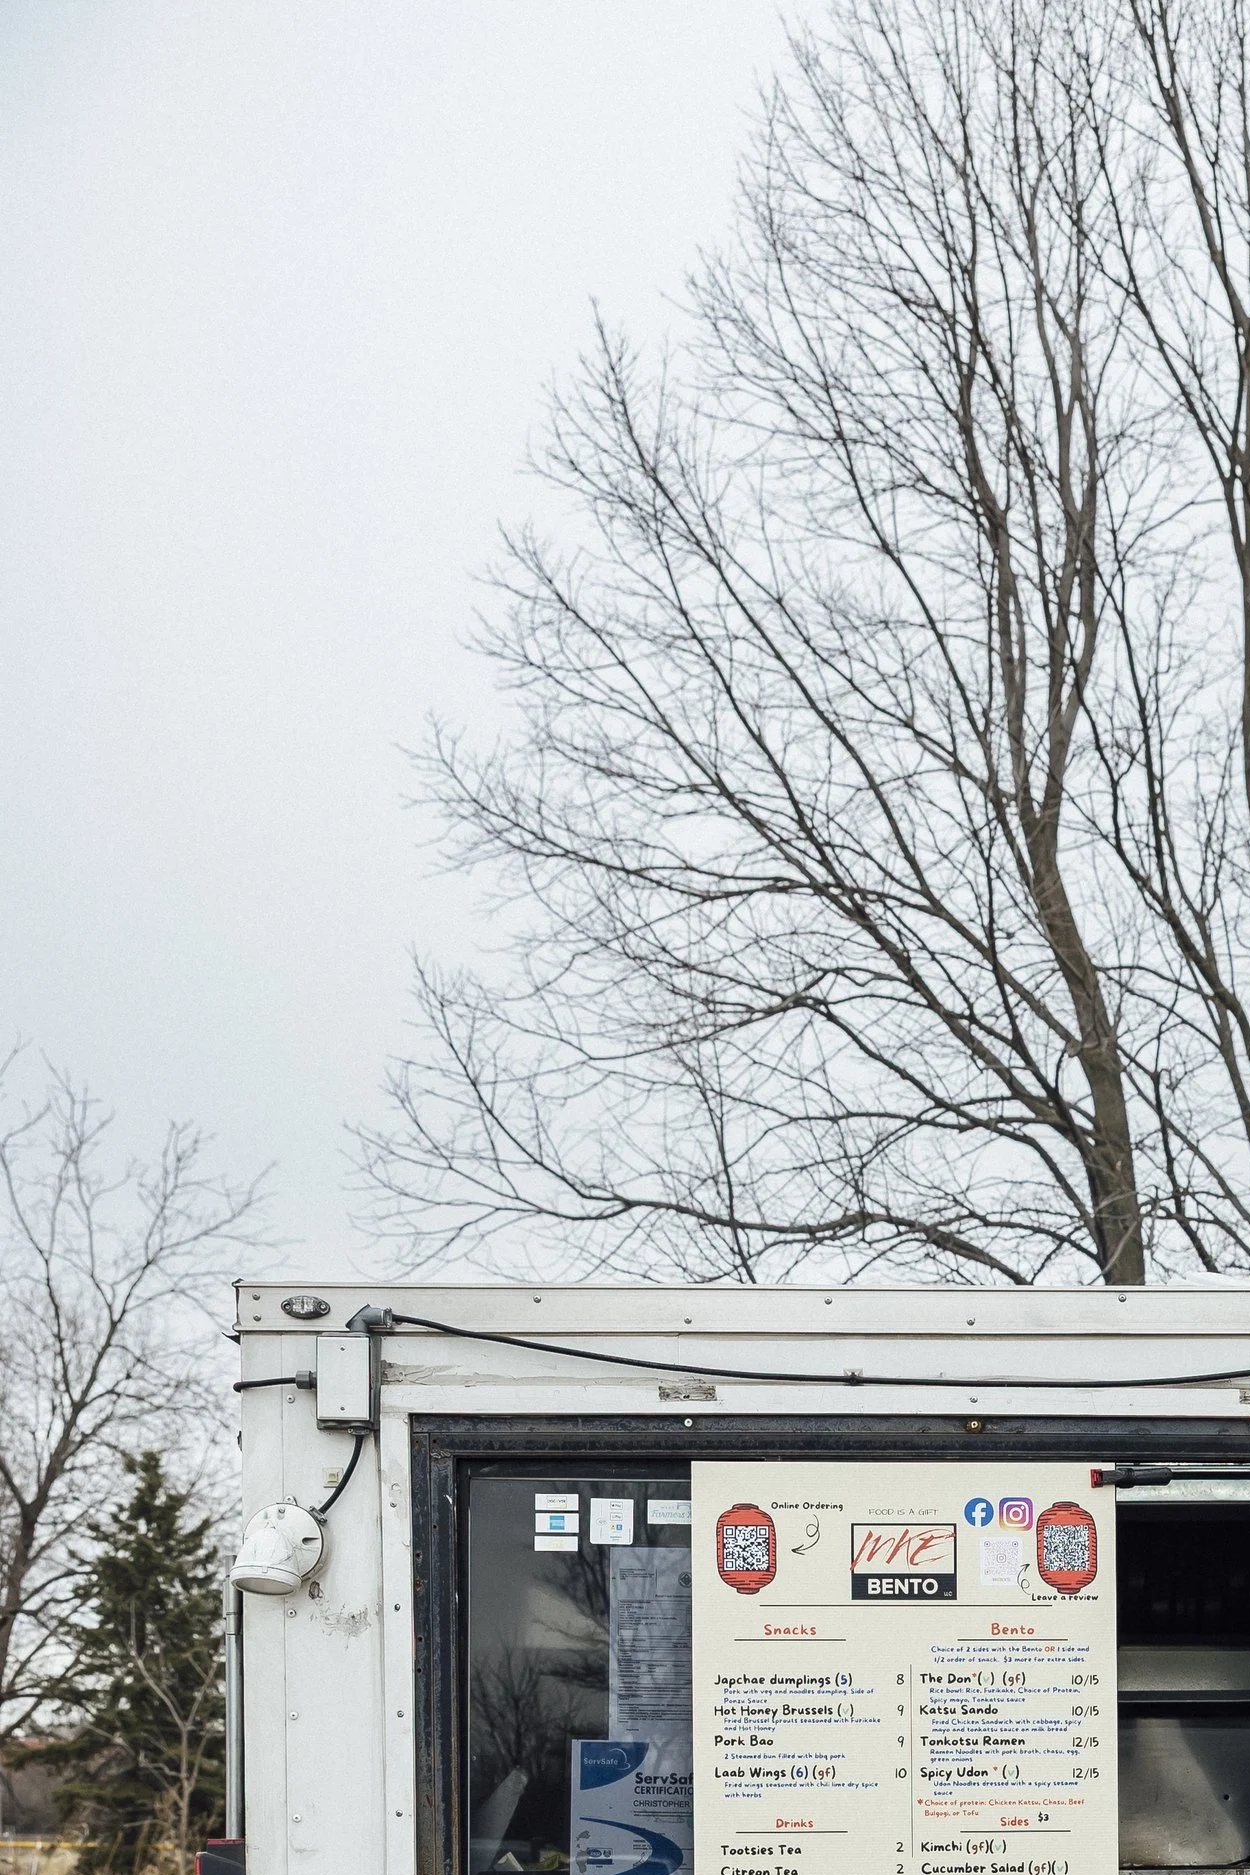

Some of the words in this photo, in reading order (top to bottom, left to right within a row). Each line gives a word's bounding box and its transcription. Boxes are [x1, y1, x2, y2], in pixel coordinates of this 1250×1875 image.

[770, 1501, 799, 1510] Online
[803, 1501, 844, 1512] Ordering
[850, 1529, 955, 1572] MKE
[867, 1578, 938, 1595] BENTO
[1031, 1593, 1059, 1602] Leave
[1071, 1593, 1099, 1601] review
[764, 1624, 816, 1636] Snacks
[991, 1623, 1035, 1636] Bento
[714, 1674, 767, 1687] Japchae
[769, 1673, 832, 1688] dumplings
[834, 1672, 853, 1687] (5)
[897, 1673, 904, 1686] 8
[714, 1735, 745, 1747] Pork
[749, 1735, 773, 1747] Bao
[897, 1736, 904, 1748] 9
[920, 1735, 979, 1747] Tonkotsu
[982, 1736, 1025, 1746] Ramen
[1072, 1736, 1099, 1749] 12/15
[583, 1757, 618, 1765] ServSafe
[814, 1753, 829, 1761] bbq
[830, 1753, 846, 1761] pork
[635, 1772, 693, 1785] ServSaf
[634, 1786, 693, 1795] CERTIFICATIO
[633, 1799, 690, 1808] CHRISTOPHER
[920, 1862, 986, 1875] Cucumber
[991, 1862, 1024, 1873] Salad
